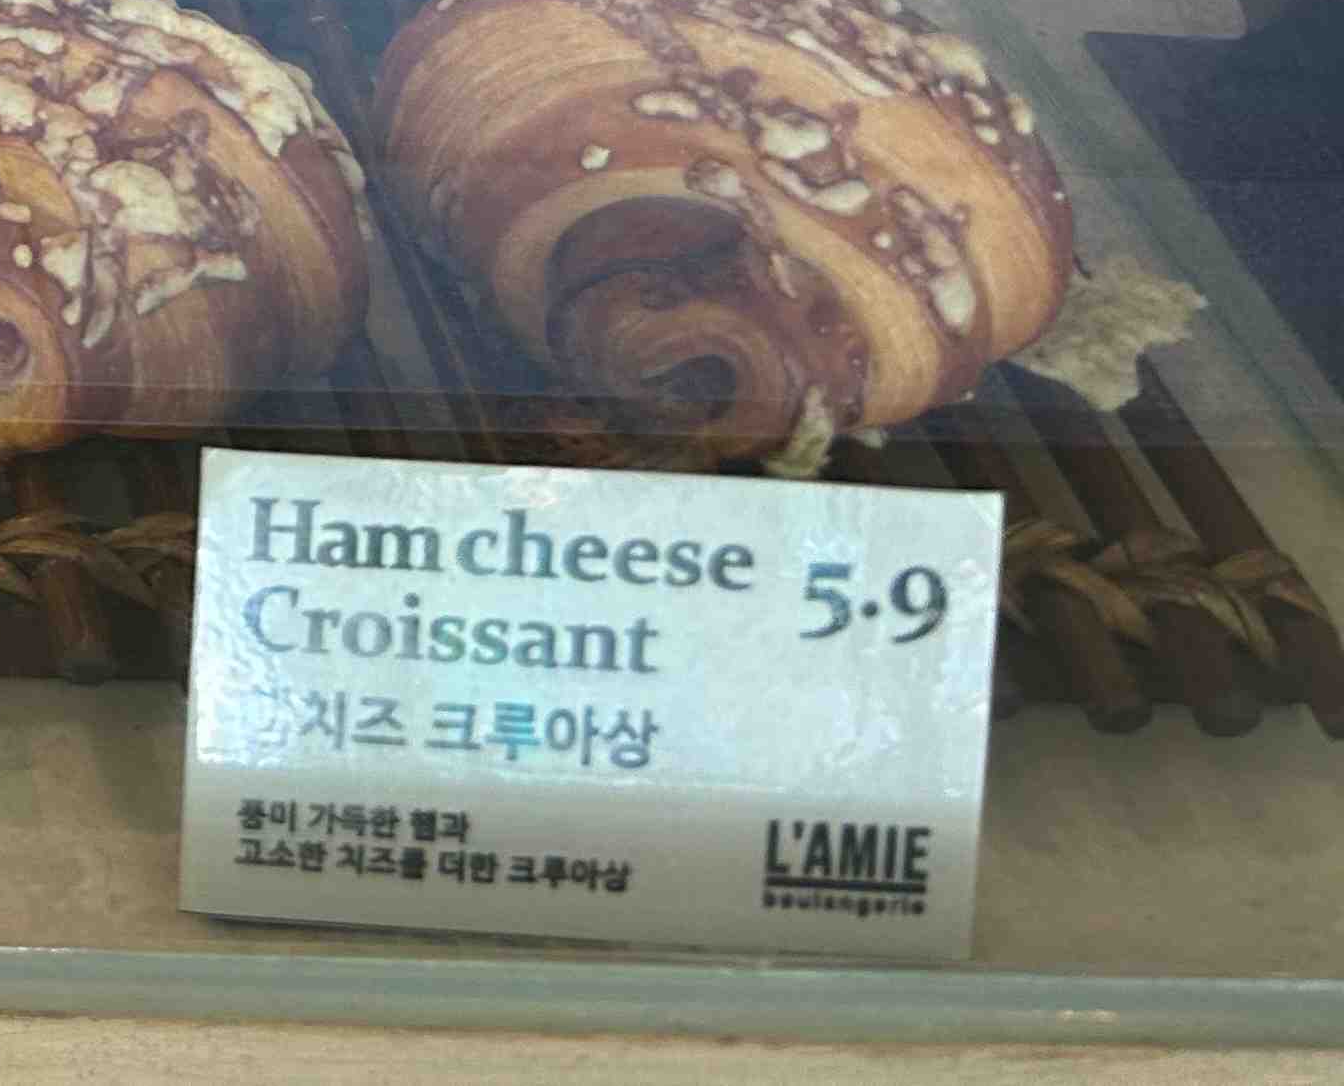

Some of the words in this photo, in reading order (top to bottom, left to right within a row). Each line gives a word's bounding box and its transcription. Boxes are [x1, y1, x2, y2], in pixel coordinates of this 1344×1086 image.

[250, 498, 439, 574] Ham
[457, 511, 754, 589] cheese
[800, 562, 948, 644] 5.9
[244, 586, 660, 674] Croissant
[424, 700, 660, 769] 크루아상
[235, 837, 327, 872] 고소한
[507, 856, 632, 893] 크루아상
[767, 819, 932, 881] L'AMIE
